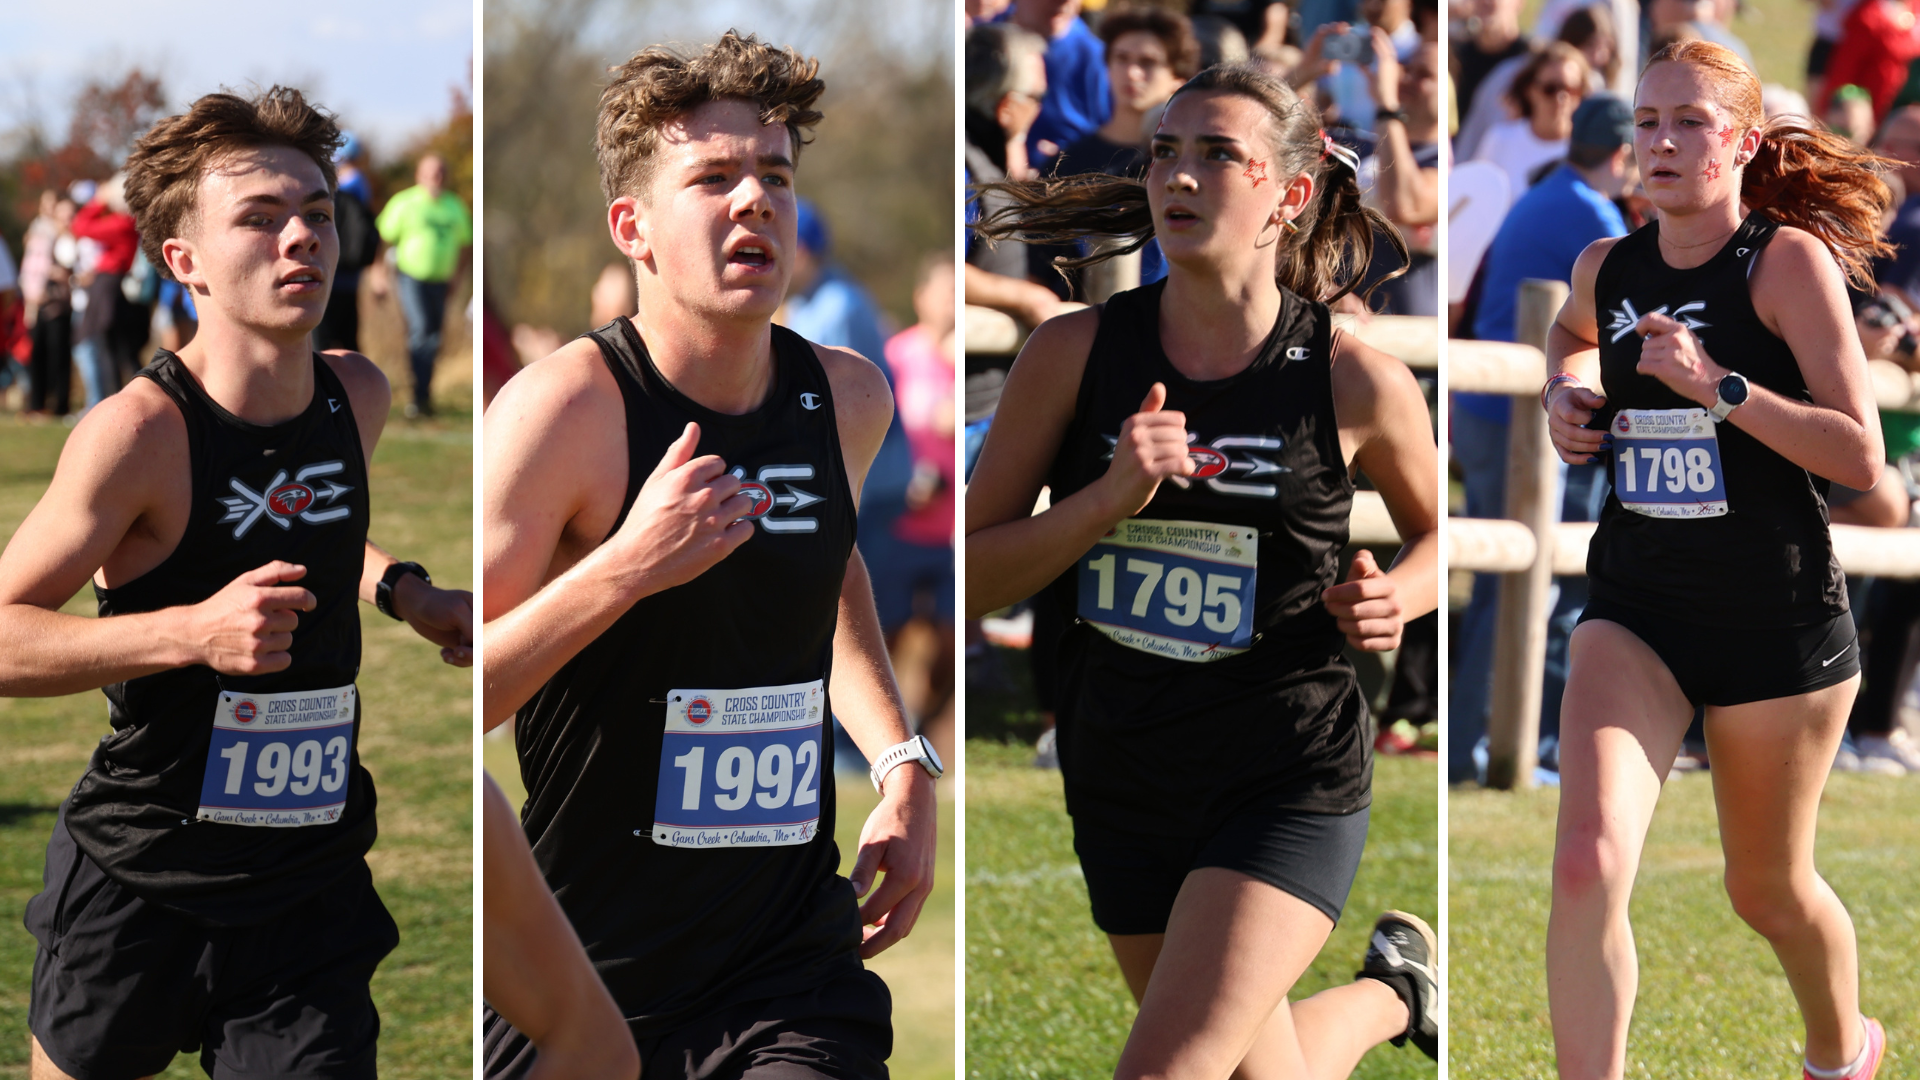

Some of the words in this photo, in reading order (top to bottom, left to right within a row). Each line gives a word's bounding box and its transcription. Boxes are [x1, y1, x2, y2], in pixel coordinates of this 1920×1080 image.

[1634, 415, 1655, 425] CROSS
[1656, 415, 1687, 425] COUNTRY
[1619, 447, 1716, 494] 1798
[1127, 523, 1163, 537] CROSS
[1166, 525, 1221, 542] COUNTRY
[1126, 533, 1154, 544] STATE
[1155, 536, 1222, 555] CHAMPIONSHIP
[1088, 553, 1242, 634] 1795
[268, 699, 297, 714] CROSS
[299, 695, 338, 711] COUNTRY
[725, 696, 758, 713] CROSS
[761, 692, 806, 711] COUNTRY
[264, 713, 287, 725] STATE
[288, 709, 338, 724] CHAMPIONSHIP
[721, 713, 747, 726] STATE
[748, 708, 807, 725] CHAMPIONSHIP
[220, 736, 347, 797] 1993
[674, 739, 818, 811] 1992
[214, 811, 233, 822] Gans
[235, 812, 257, 824] Creek
[672, 830, 695, 846] Gans
[697, 831, 721, 845] Creek
